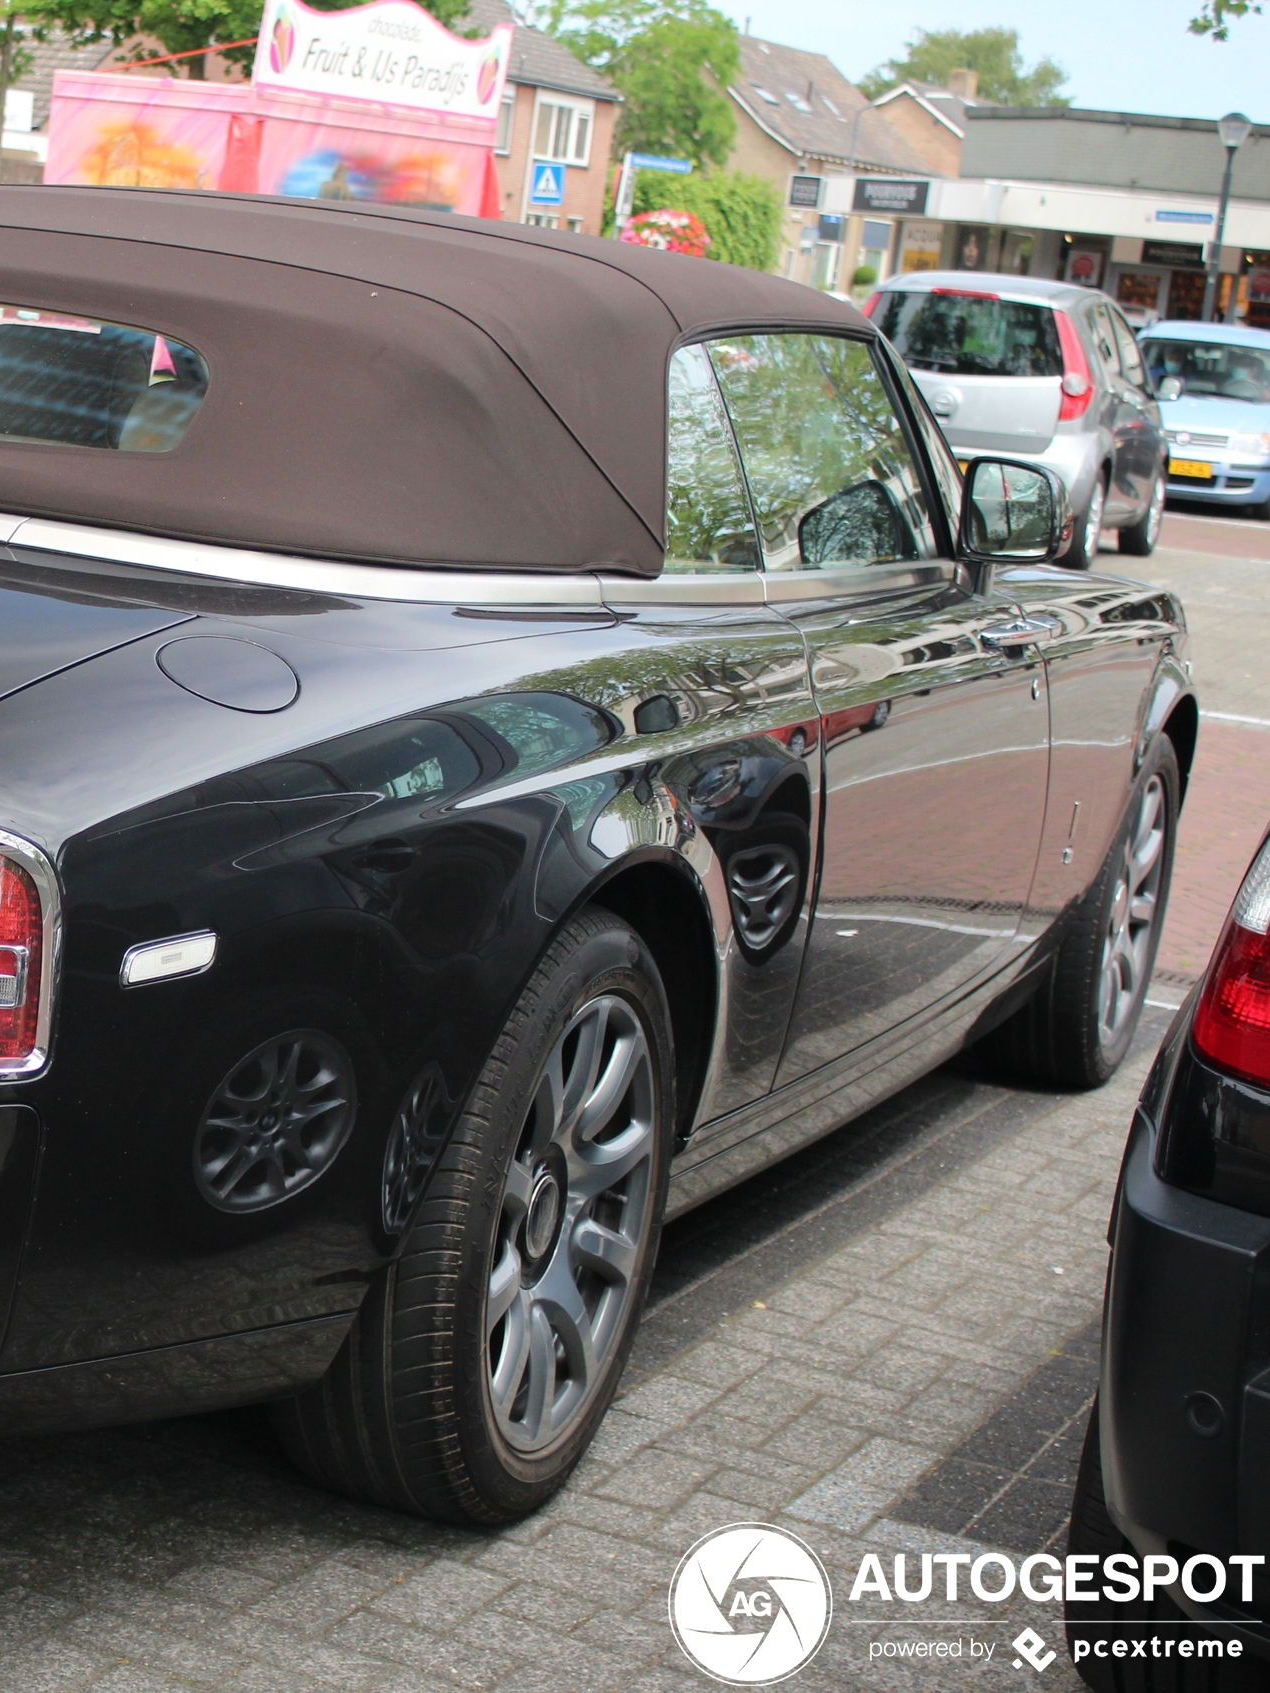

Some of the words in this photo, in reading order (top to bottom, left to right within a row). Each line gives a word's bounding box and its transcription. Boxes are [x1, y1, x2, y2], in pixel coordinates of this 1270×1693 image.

[302, 38, 349, 76] Fruit
[352, 47, 367, 78] &
[401, 55, 470, 104] Paradijs
